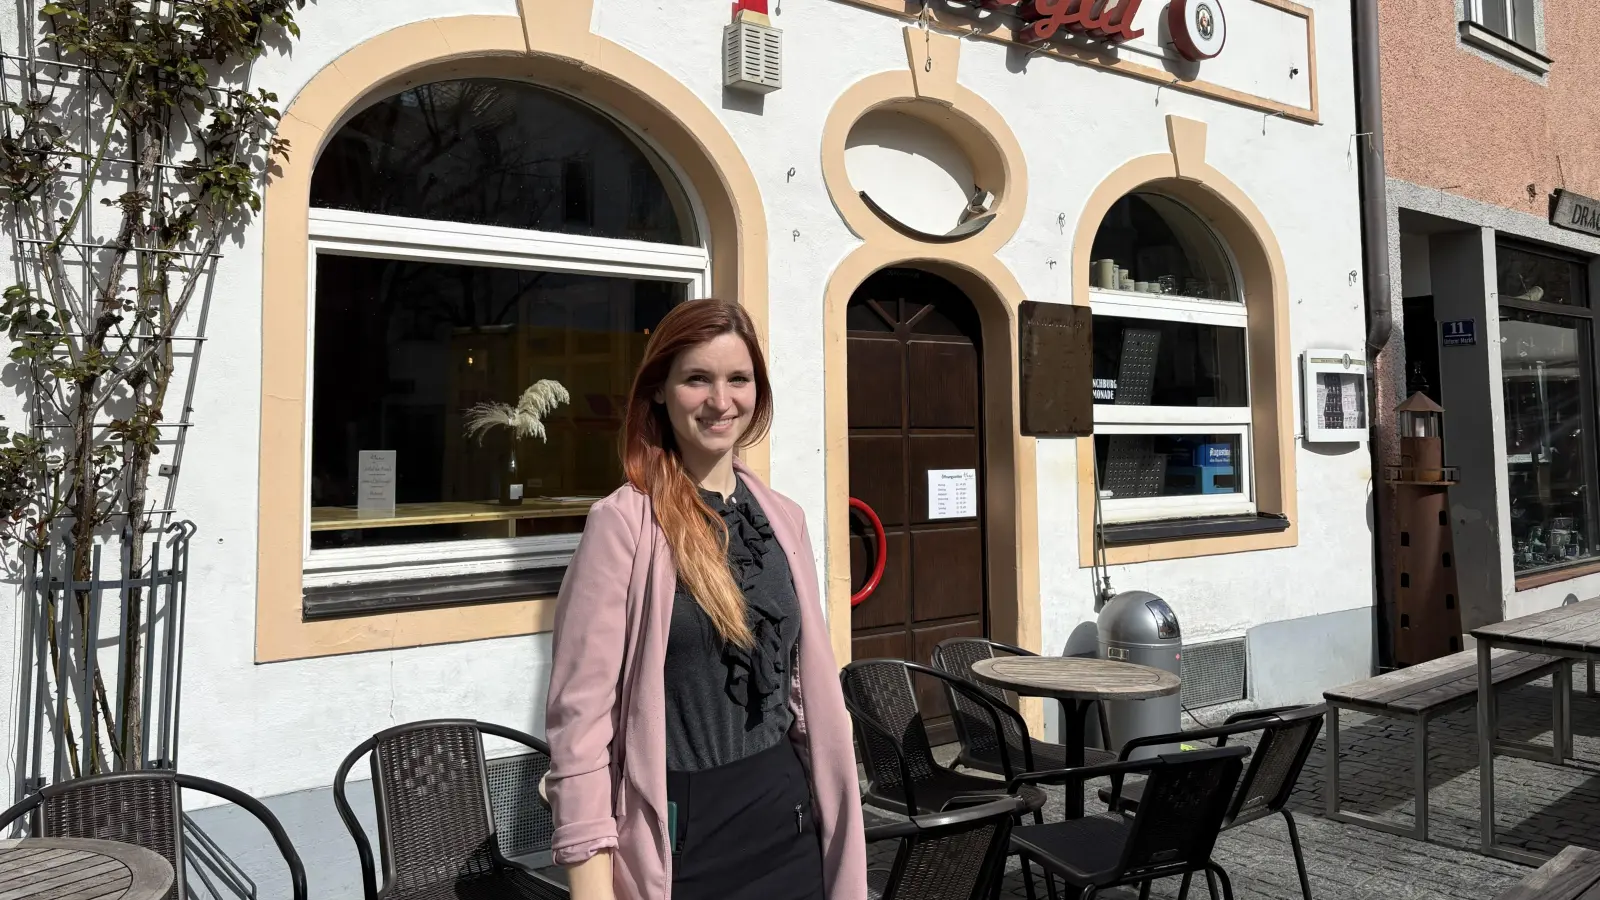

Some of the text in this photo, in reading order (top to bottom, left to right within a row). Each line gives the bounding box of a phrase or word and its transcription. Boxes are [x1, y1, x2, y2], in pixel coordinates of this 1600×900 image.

[1450, 321, 1465, 334] 11
[1092, 378, 1117, 389] NCHBURG
[1092, 389, 1114, 400] MONADE
